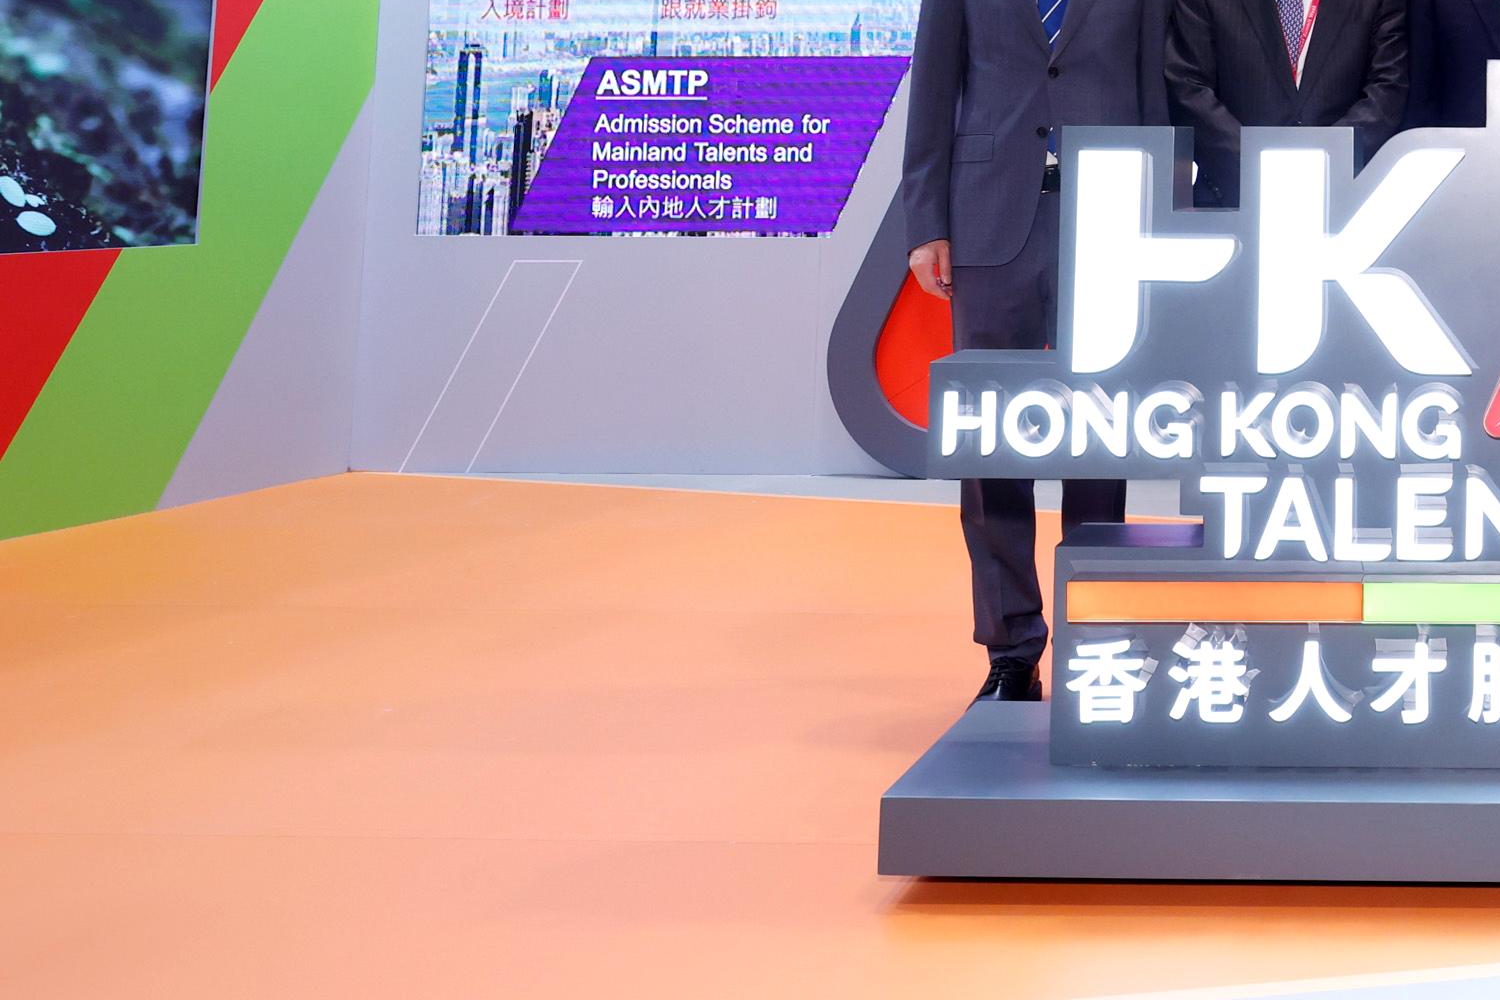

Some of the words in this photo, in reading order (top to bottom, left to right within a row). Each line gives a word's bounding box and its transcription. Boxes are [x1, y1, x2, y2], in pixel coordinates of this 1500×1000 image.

[596, 70, 709, 96] ASMTP
[594, 113, 702, 134] Admission
[708, 113, 794, 134] Scheme
[801, 113, 830, 134] for
[592, 141, 686, 162] Mainland
[694, 141, 768, 162] Talents
[773, 142, 813, 162] and
[592, 169, 733, 190] Professionals
[940, 389, 1193, 459] HONG
[1220, 390, 1462, 460] KONG
